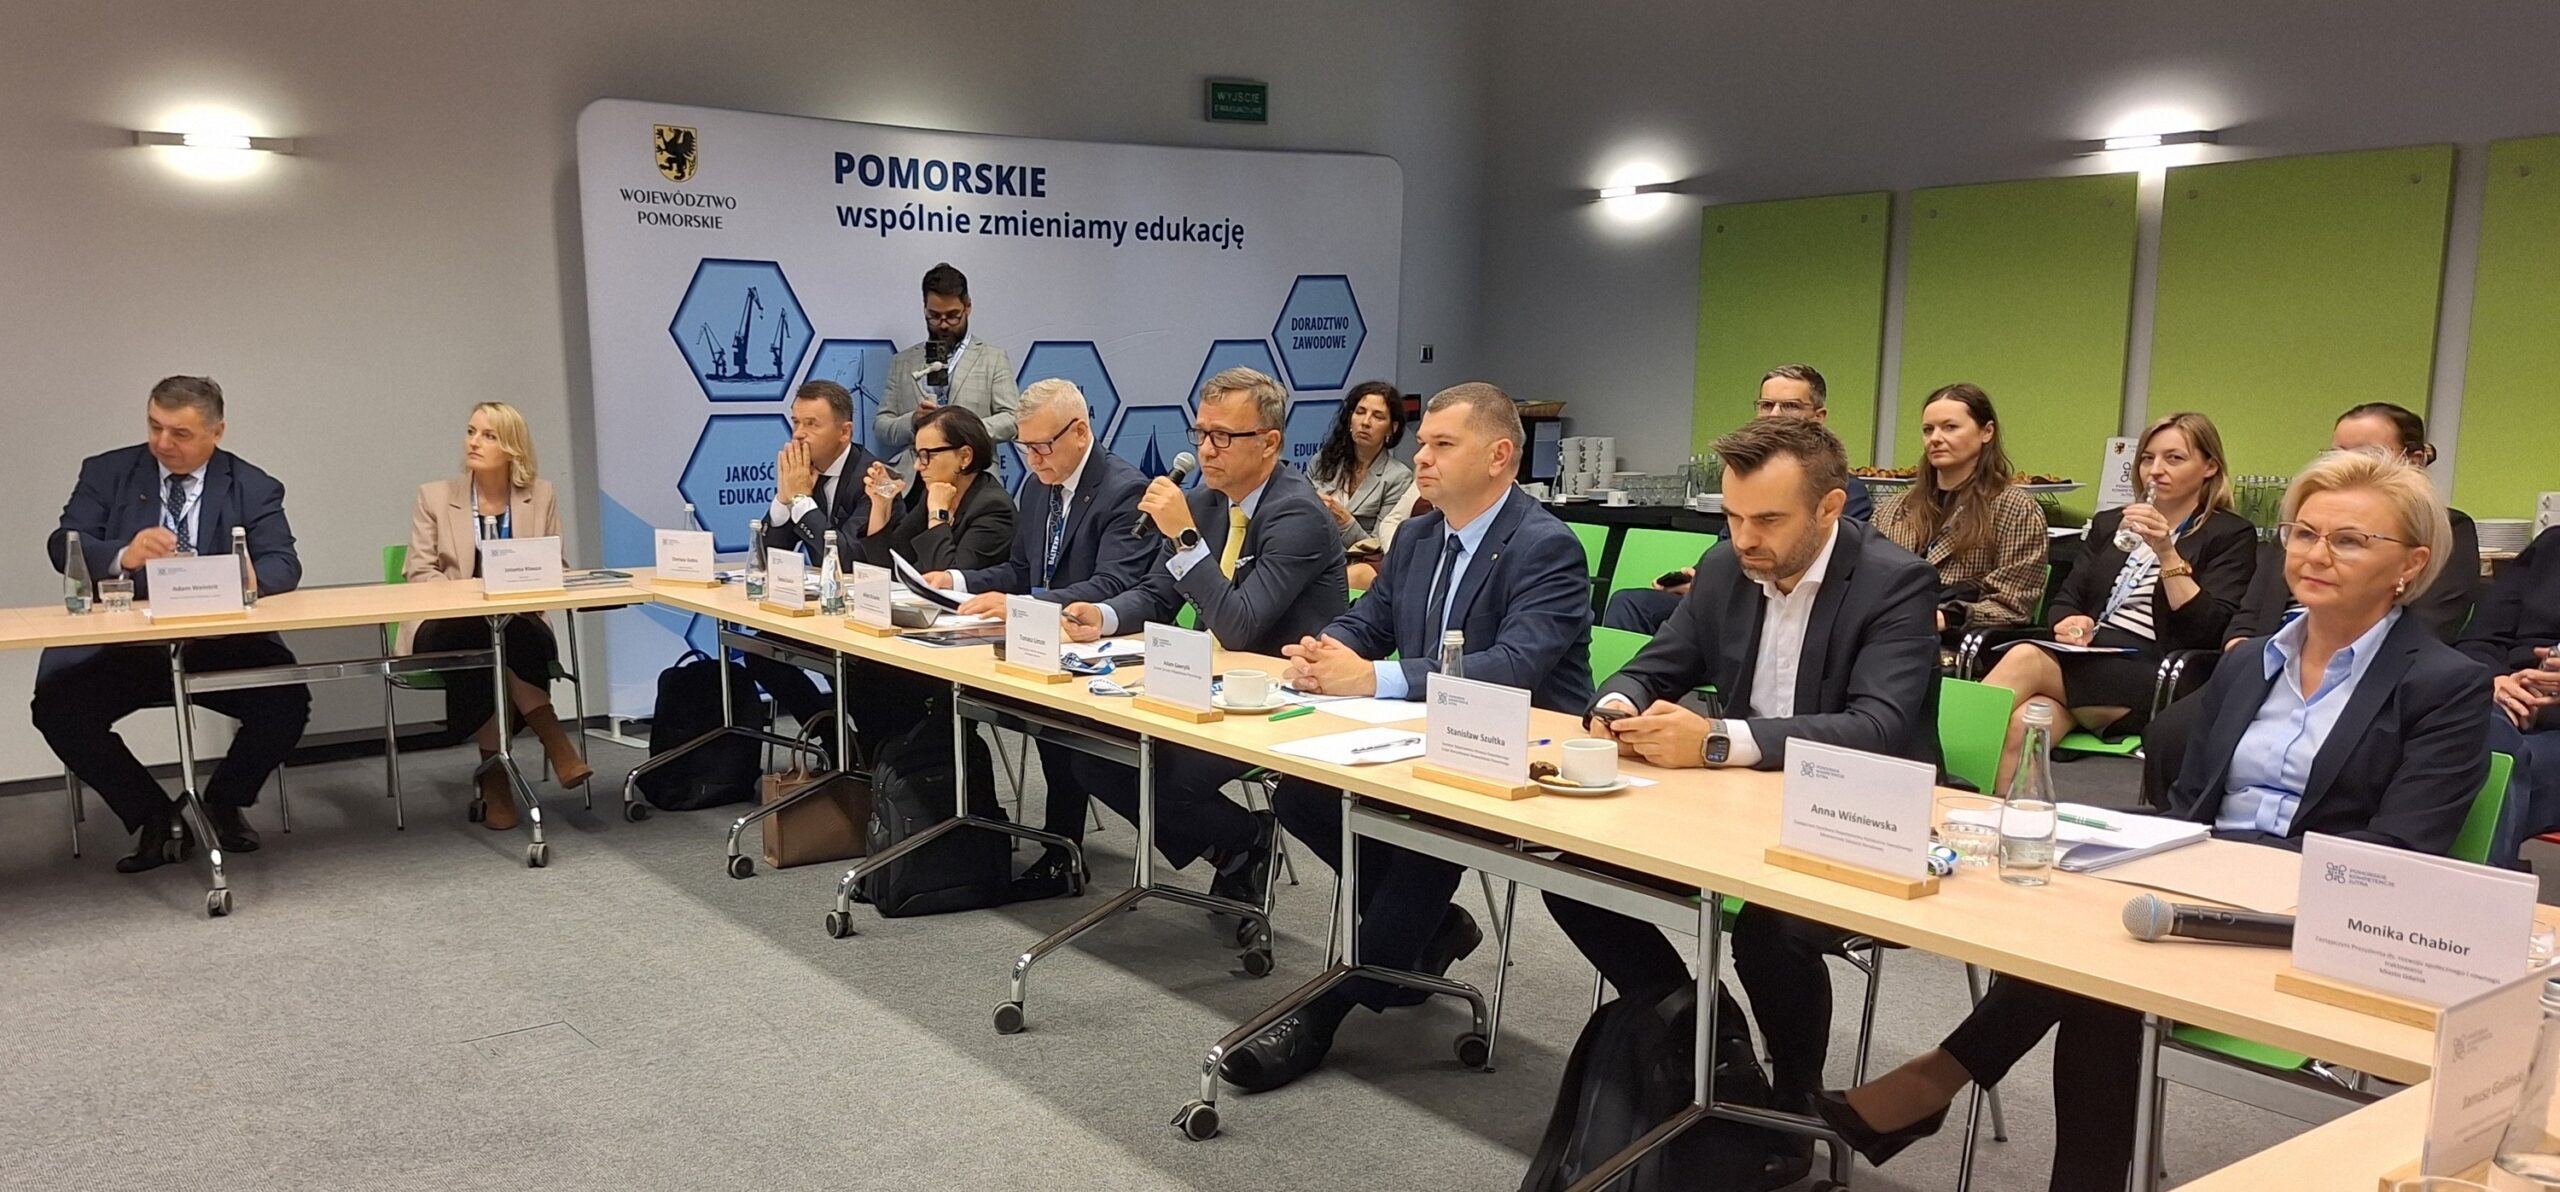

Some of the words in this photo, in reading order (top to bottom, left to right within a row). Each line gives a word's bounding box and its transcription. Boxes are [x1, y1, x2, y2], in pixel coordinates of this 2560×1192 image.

[834, 151, 1046, 197] POMORSKIE
[620, 188, 737, 210] WOJEWÓDZTWO
[637, 211, 724, 230] POMORSKIE
[837, 202, 971, 237] wspólnie
[979, 209, 1128, 247] zmieniamy
[1135, 215, 1245, 250] edukację
[1291, 316, 1349, 331] DORADZTWO
[1293, 335, 1346, 350] ZAWODOWE
[725, 462, 774, 483] JAKOŚĆ
[1446, 726, 1479, 741] Stanisław
[1480, 733, 1506, 747] Szultka
[1811, 804, 1836, 817] Anna
[1838, 809, 1898, 832] Wiśniewska
[2347, 918, 2404, 941] Monika
[2409, 932, 2471, 957] Chabior
